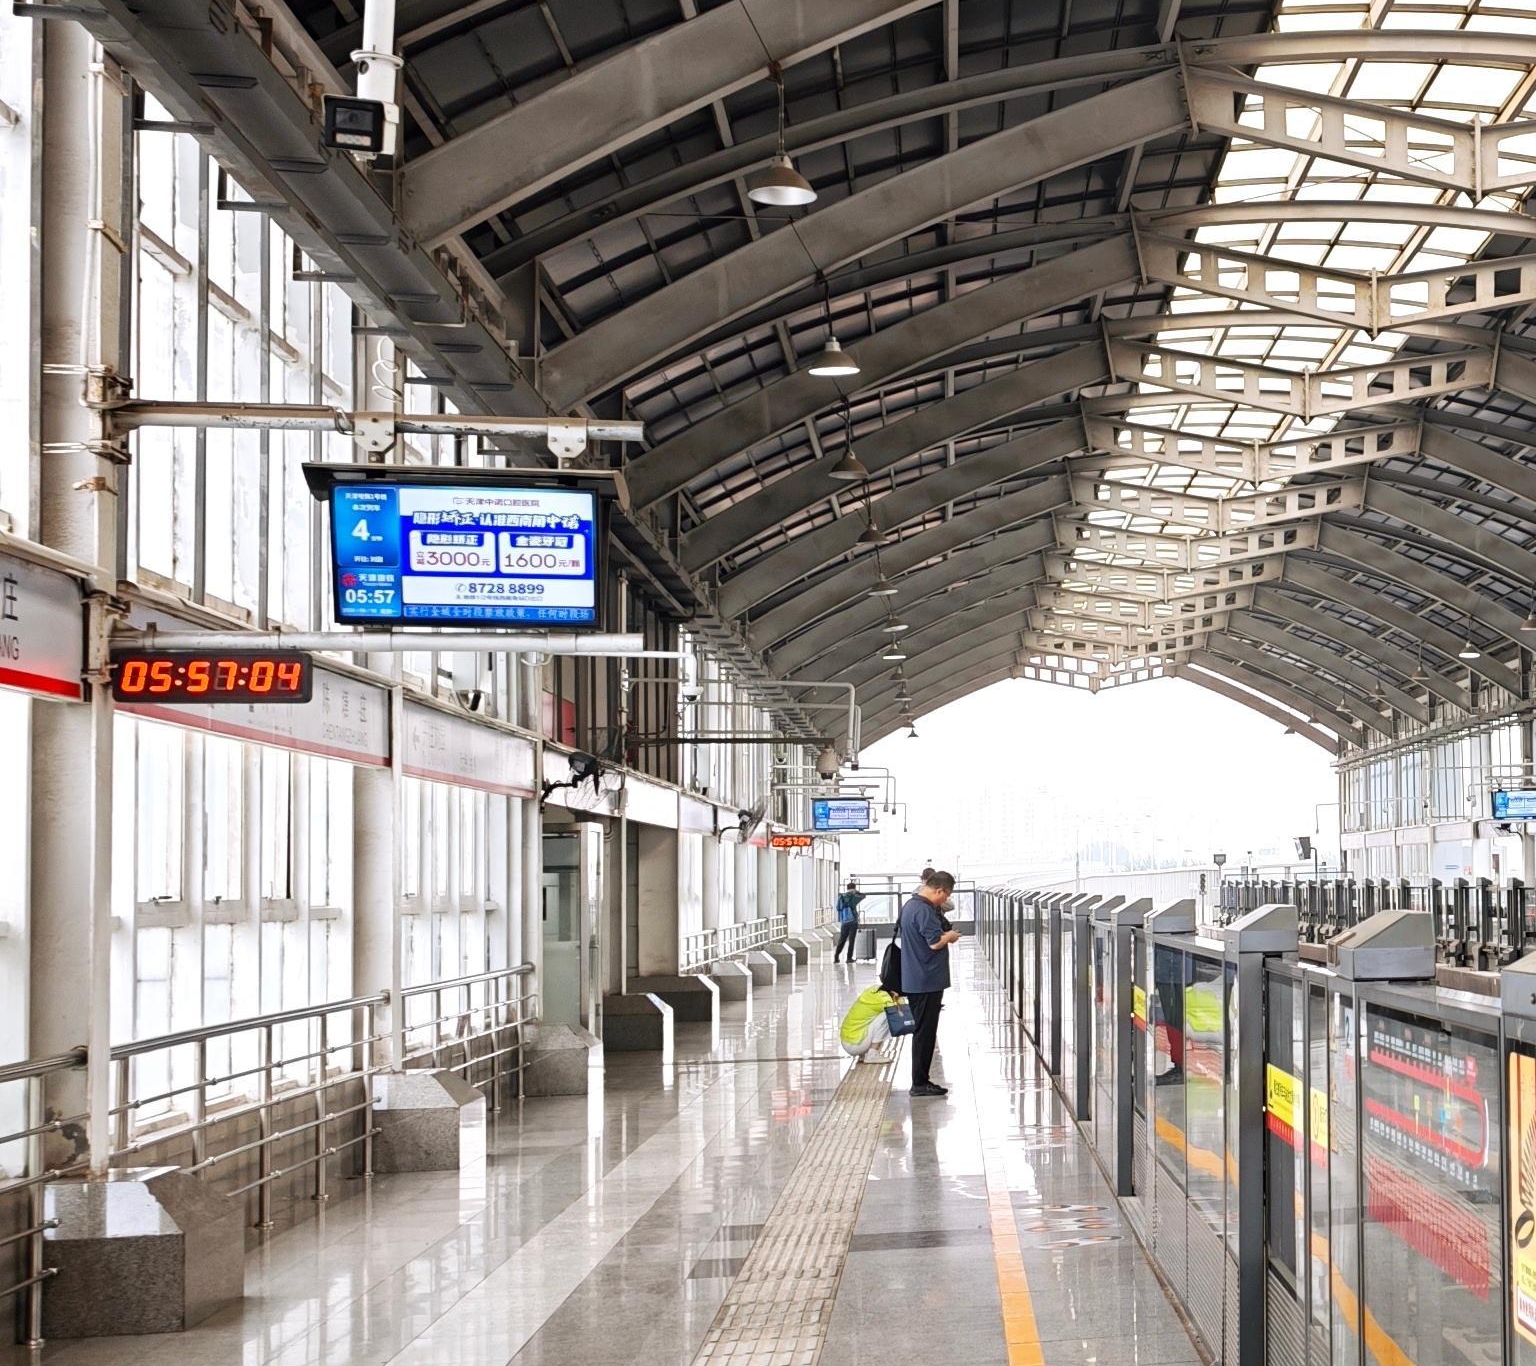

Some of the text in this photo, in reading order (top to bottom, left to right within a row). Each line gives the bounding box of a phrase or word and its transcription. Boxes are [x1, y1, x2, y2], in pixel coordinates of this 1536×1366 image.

[352, 519, 371, 541] 4
[345, 589, 395, 604] 05:57
[468, 583, 545, 595] 8728 8899
[119, 661, 301, 693] 05:57:04
